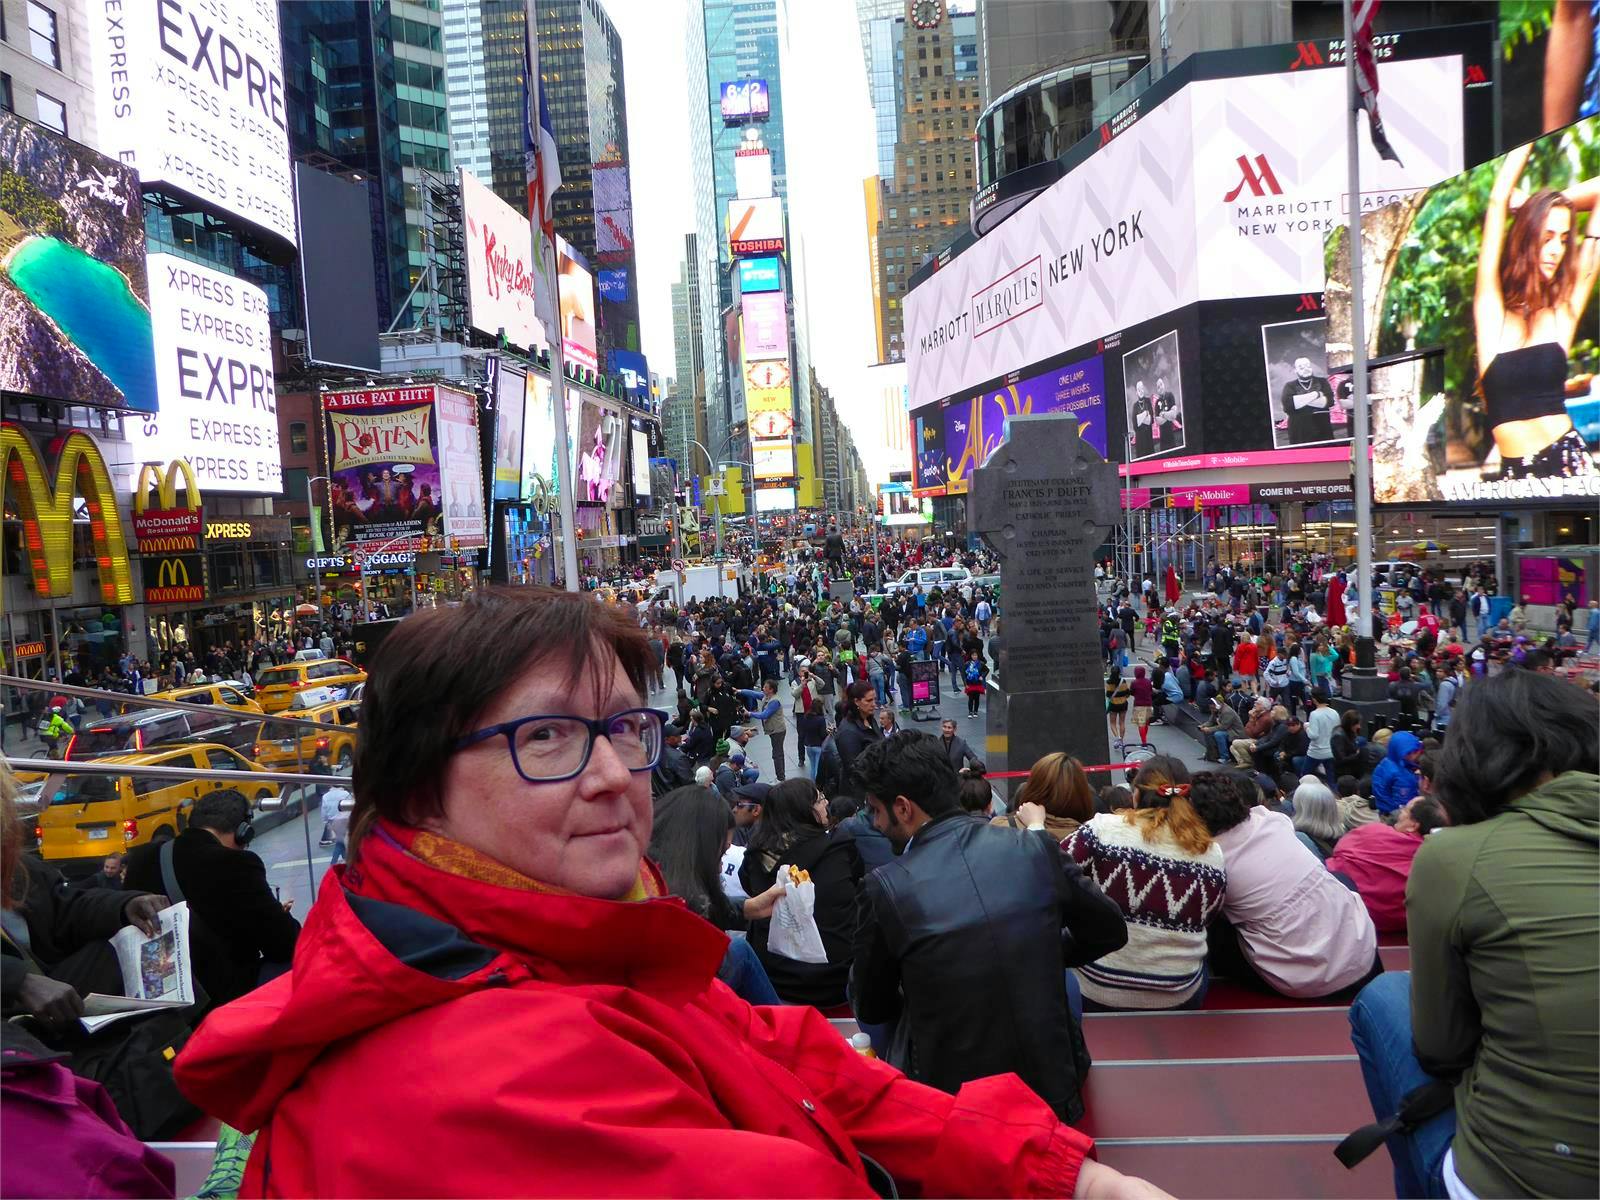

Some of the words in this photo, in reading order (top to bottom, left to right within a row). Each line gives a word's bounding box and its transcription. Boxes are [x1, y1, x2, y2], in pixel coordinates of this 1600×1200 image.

[105, 0, 131, 118] EXPRESS
[1111, 99, 1140, 126] MARRIOTT
[1112, 112, 1137, 136] MARQUIS
[735, 148, 769, 157] TOSHIBA
[1238, 200, 1333, 218] MARRIOTT
[1238, 224, 1277, 236] NEW
[1286, 219, 1333, 233] YORK
[732, 239, 783, 252] TOSHIBA
[483, 223, 514, 301] Kinky
[920, 312, 969, 356] MARRIOTT
[976, 272, 1038, 327] MARQUIS
[1049, 244, 1084, 287] NEW
[1091, 210, 1144, 262] YORK
[180, 308, 254, 347] EXPRESS
[372, 391, 395, 403] FAT
[345, 412, 417, 425] SOMETHING
[190, 418, 261, 446] EXPRESS
[336, 413, 428, 463] ROTTEN!
[1008, 479, 1049, 488] LIEUTENANT
[1051, 477, 1086, 486] COLONEL
[1446, 477, 1561, 501] AMERICAN
[1003, 488, 1045, 499] FRANCIS
[1057, 486, 1092, 497] DUFFY
[1260, 488, 1283, 496] COME
[1301, 486, 1327, 495] WE'RE
[1328, 485, 1352, 493] OPEN.
[137, 515, 199, 528] McDonald's
[1016, 512, 1051, 520] CATHOLIC
[1055, 510, 1081, 519] PRIEST
[147, 526, 189, 534] Restaurant
[205, 523, 251, 538] XPRESS
[1032, 529, 1067, 537] CHAPLAIN
[306, 556, 345, 568] GIFTS
[727, 863, 736, 876] R
